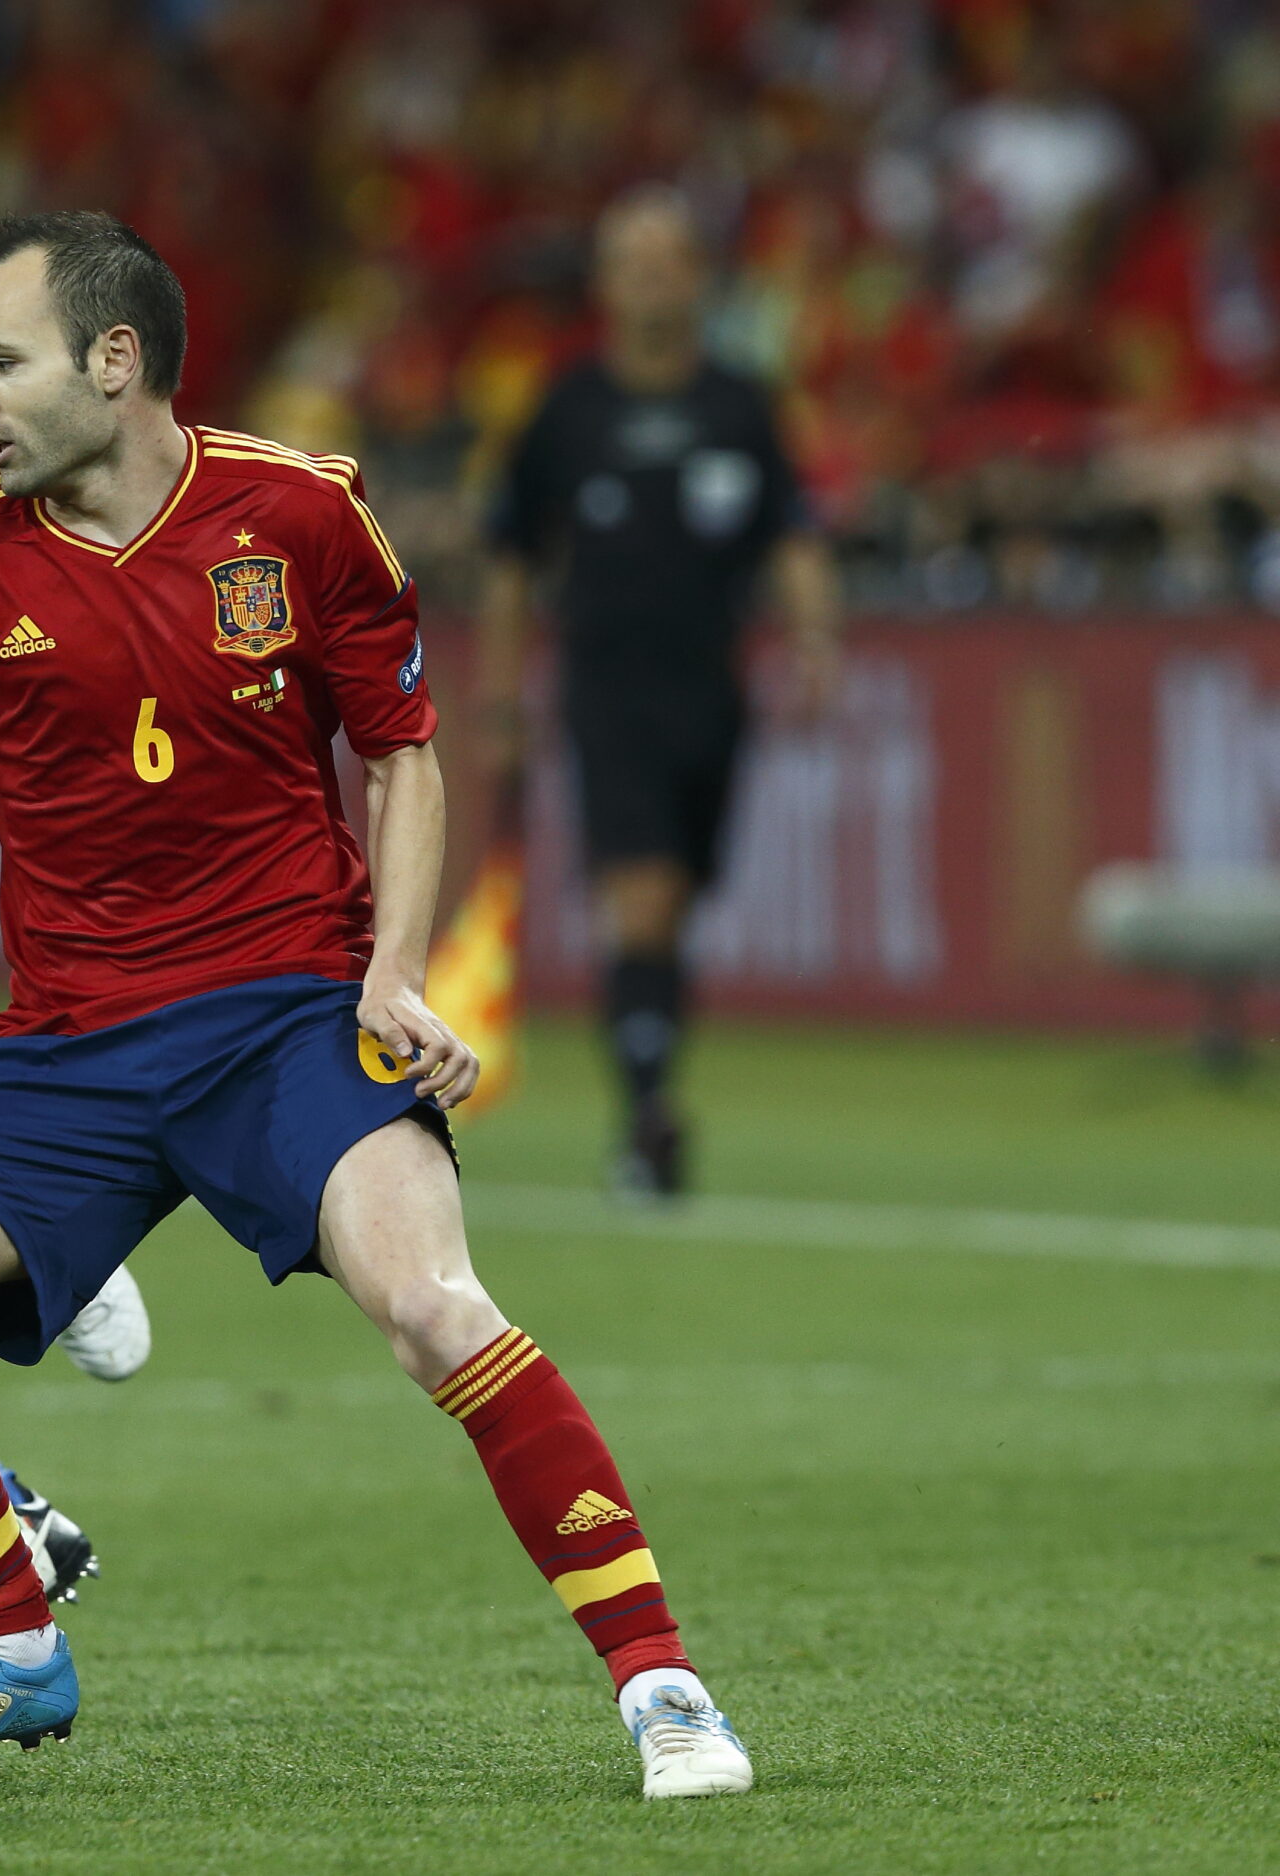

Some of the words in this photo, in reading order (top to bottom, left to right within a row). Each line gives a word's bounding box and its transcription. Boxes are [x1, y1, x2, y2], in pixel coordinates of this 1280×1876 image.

[0, 638, 56, 659] adidas
[257, 697, 274, 709] JULIO
[133, 697, 175, 783] 6
[555, 1508, 633, 1536] adidas
